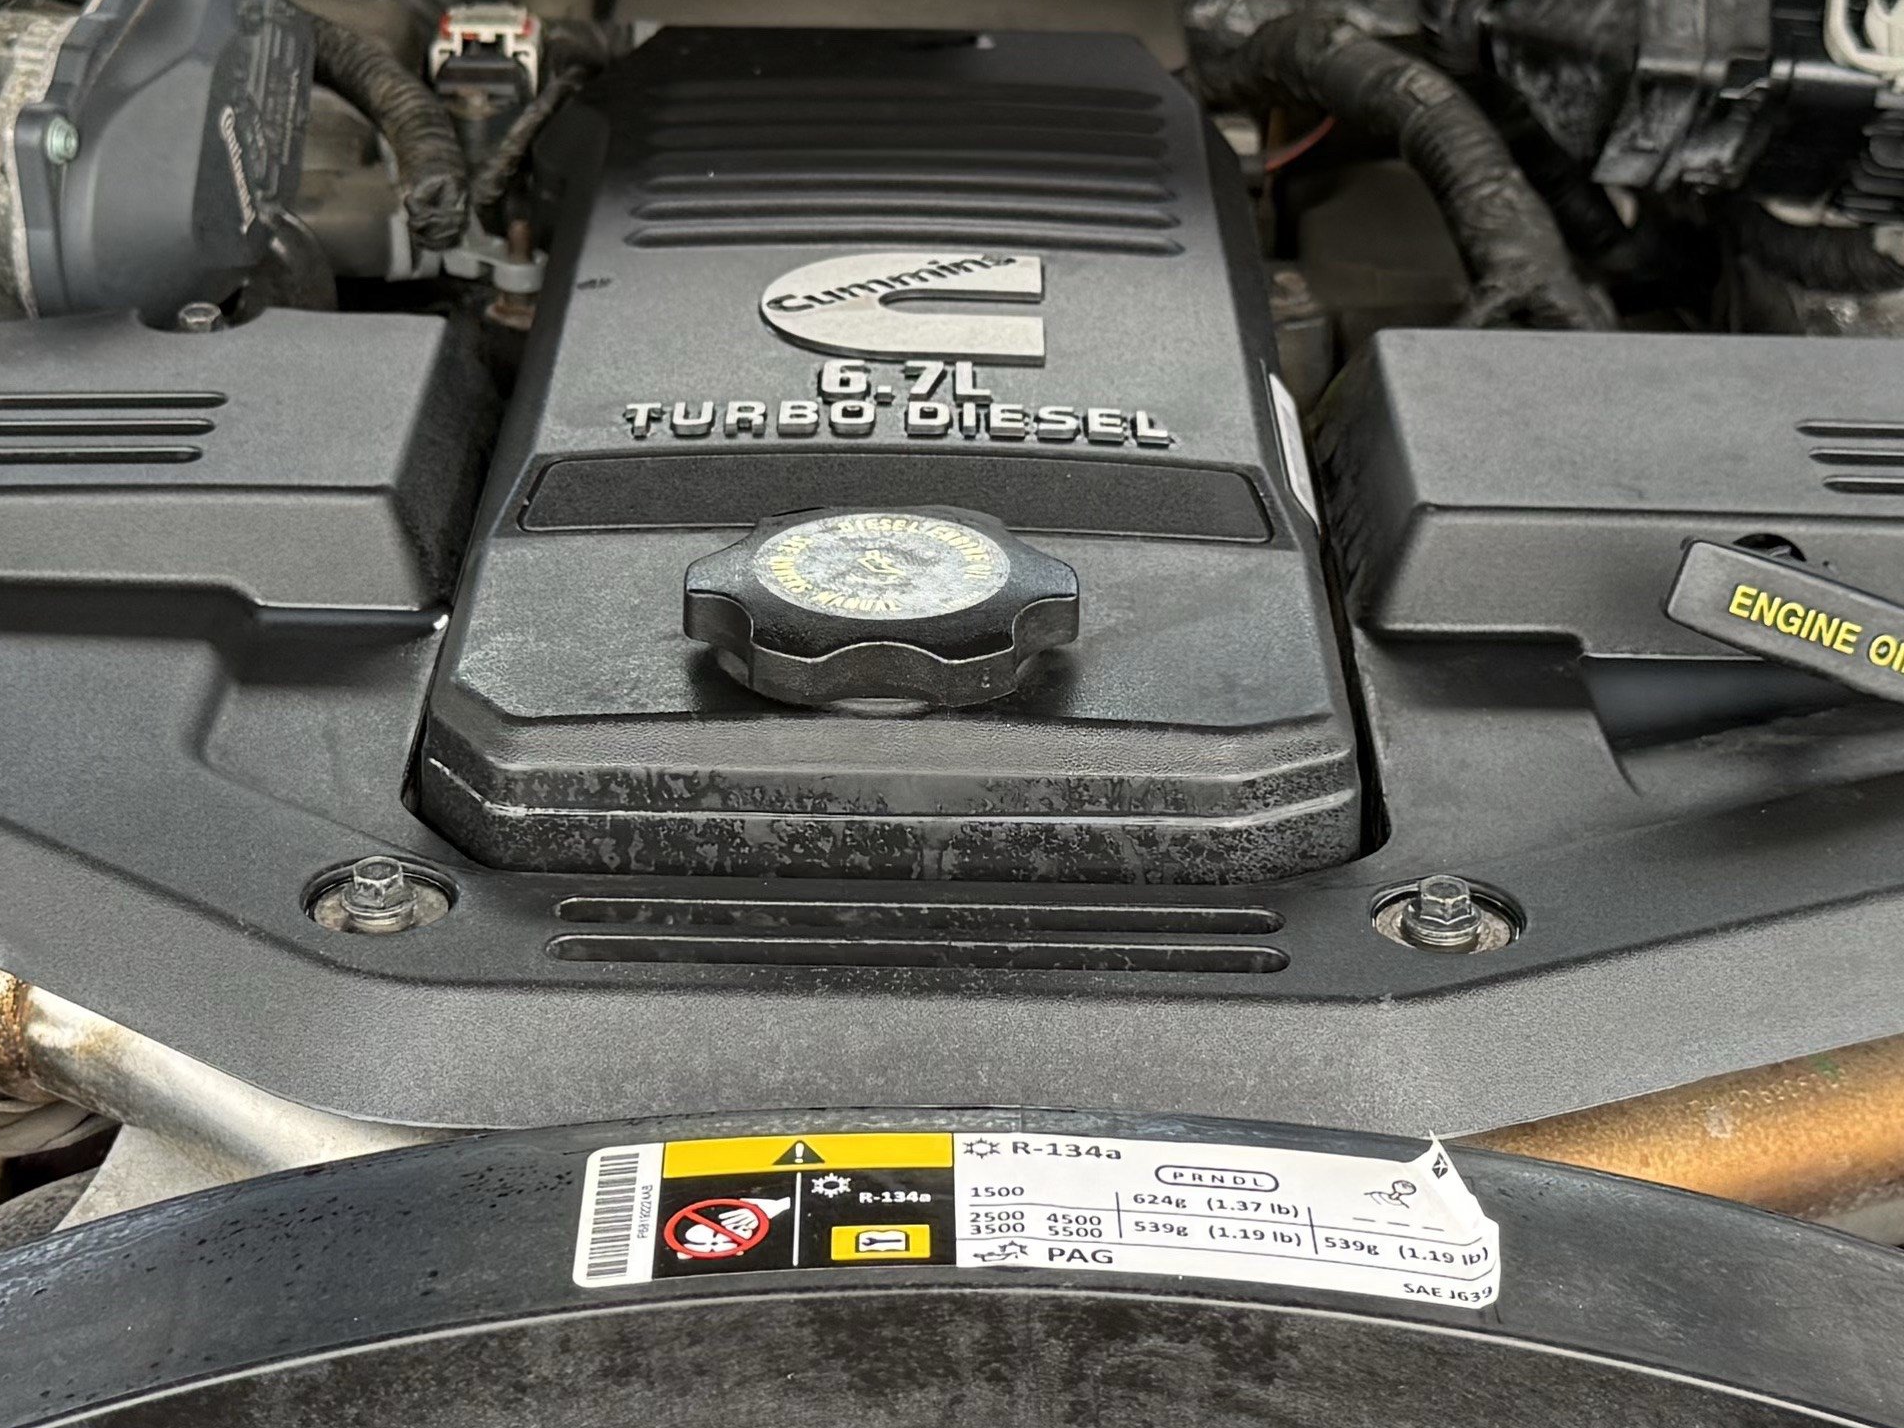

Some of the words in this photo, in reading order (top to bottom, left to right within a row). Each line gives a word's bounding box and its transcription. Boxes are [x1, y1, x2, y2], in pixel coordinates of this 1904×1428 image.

[819, 360, 993, 402] 6.7L
[626, 400, 878, 439] TURBO
[905, 402, 1178, 446] DIESEL
[838, 518, 920, 533] DIESEL
[926, 525, 991, 562] ENGINE
[810, 590, 903, 612] MANUAL
[1728, 583, 1862, 656] ENGINE
[1011, 1138, 1122, 1161] R-134a
[858, 1190, 931, 1204] R-134a
[970, 1186, 1025, 1198] 1500
[1133, 1193, 1188, 1211] 624g
[1206, 1194, 1267, 1216] (1.37
[1270, 1201, 1299, 1218] lb)
[969, 1211, 1025, 1223] 2500
[1046, 1212, 1102, 1227] 4500
[969, 1223, 1025, 1236] 3500
[1047, 1225, 1103, 1240] 5500
[1134, 1220, 1189, 1238] 539g
[1208, 1223, 1269, 1243] (1.19
[1272, 1230, 1302, 1248] lb)
[1047, 1247, 1114, 1265] PAG
[1323, 1236, 1380, 1257] 539g
[1398, 1245, 1456, 1265] (1.19
[1460, 1245, 1490, 1267] lb)
[1403, 1282, 1442, 1298] SAE
[1448, 1284, 1494, 1303] J639
